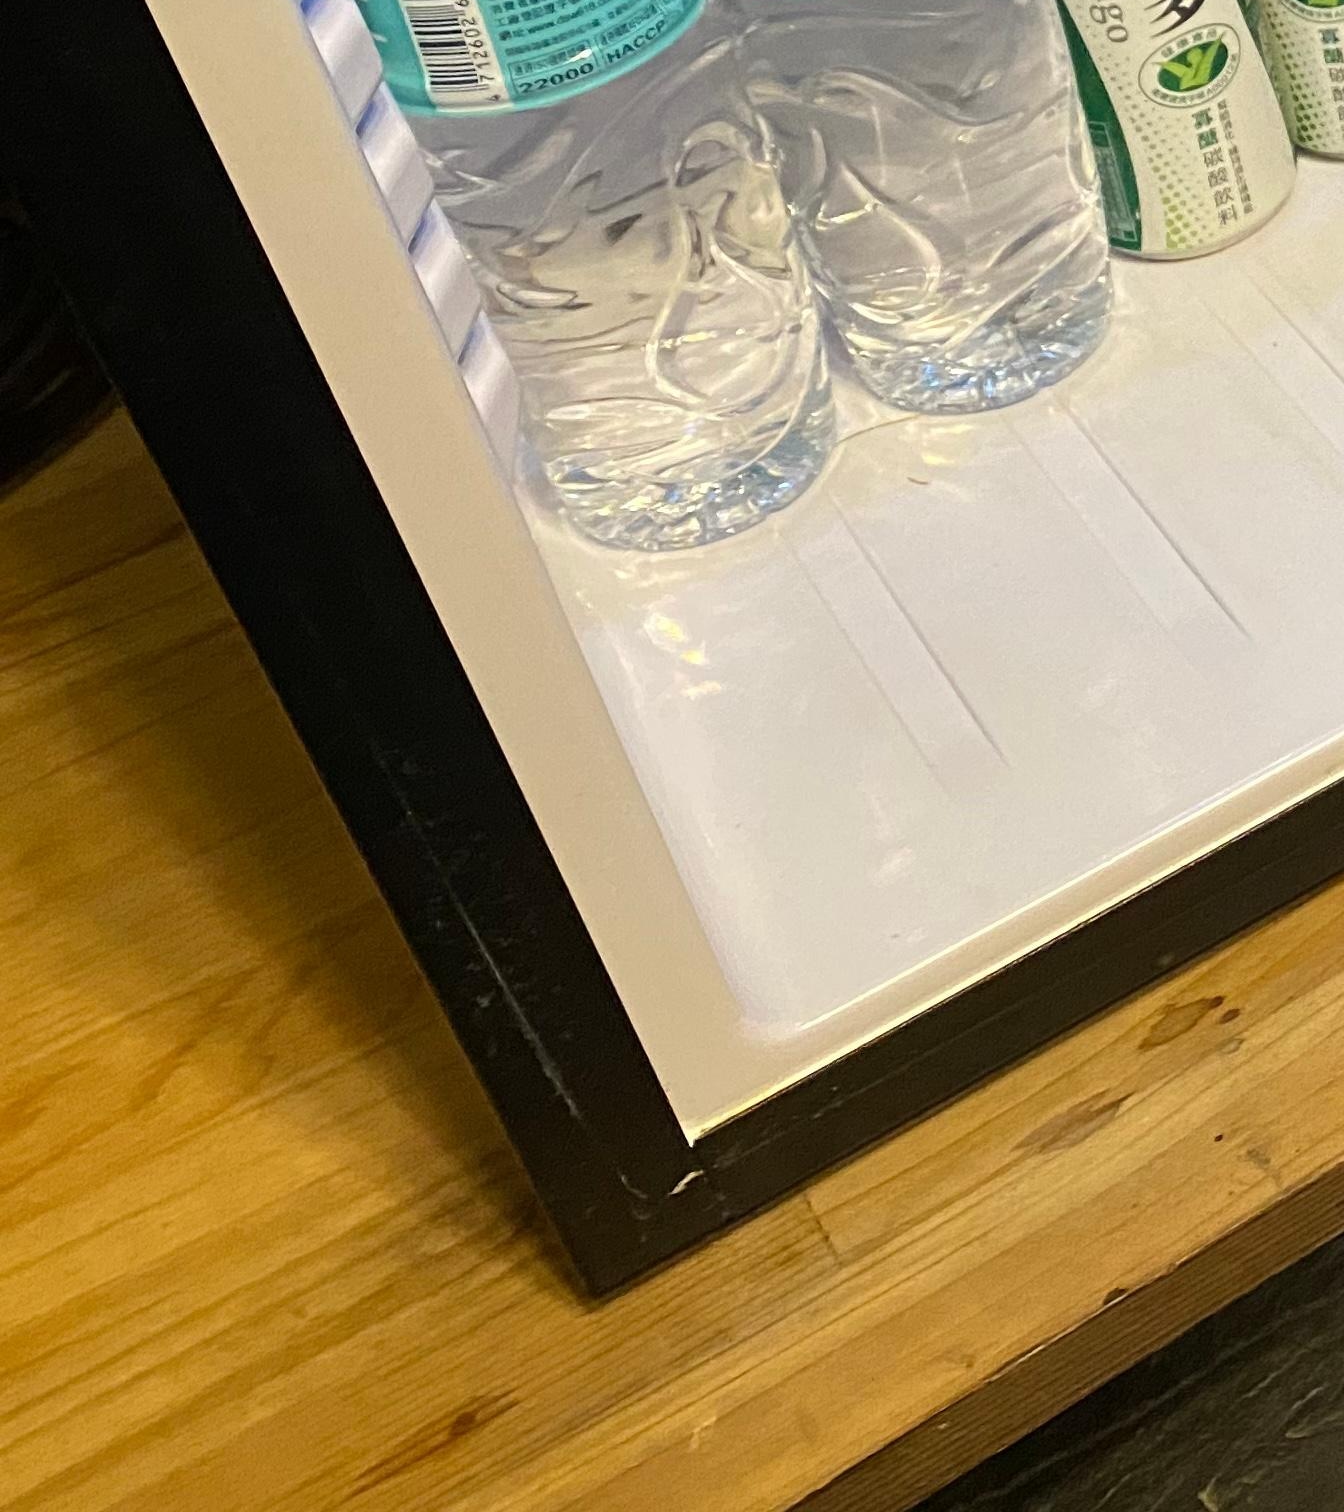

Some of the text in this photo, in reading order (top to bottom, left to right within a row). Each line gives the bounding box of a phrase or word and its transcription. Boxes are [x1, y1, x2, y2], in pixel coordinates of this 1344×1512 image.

[460, 15, 496, 84] 712602
[606, 19, 667, 65] HACCP
[518, 62, 594, 94] 22000
